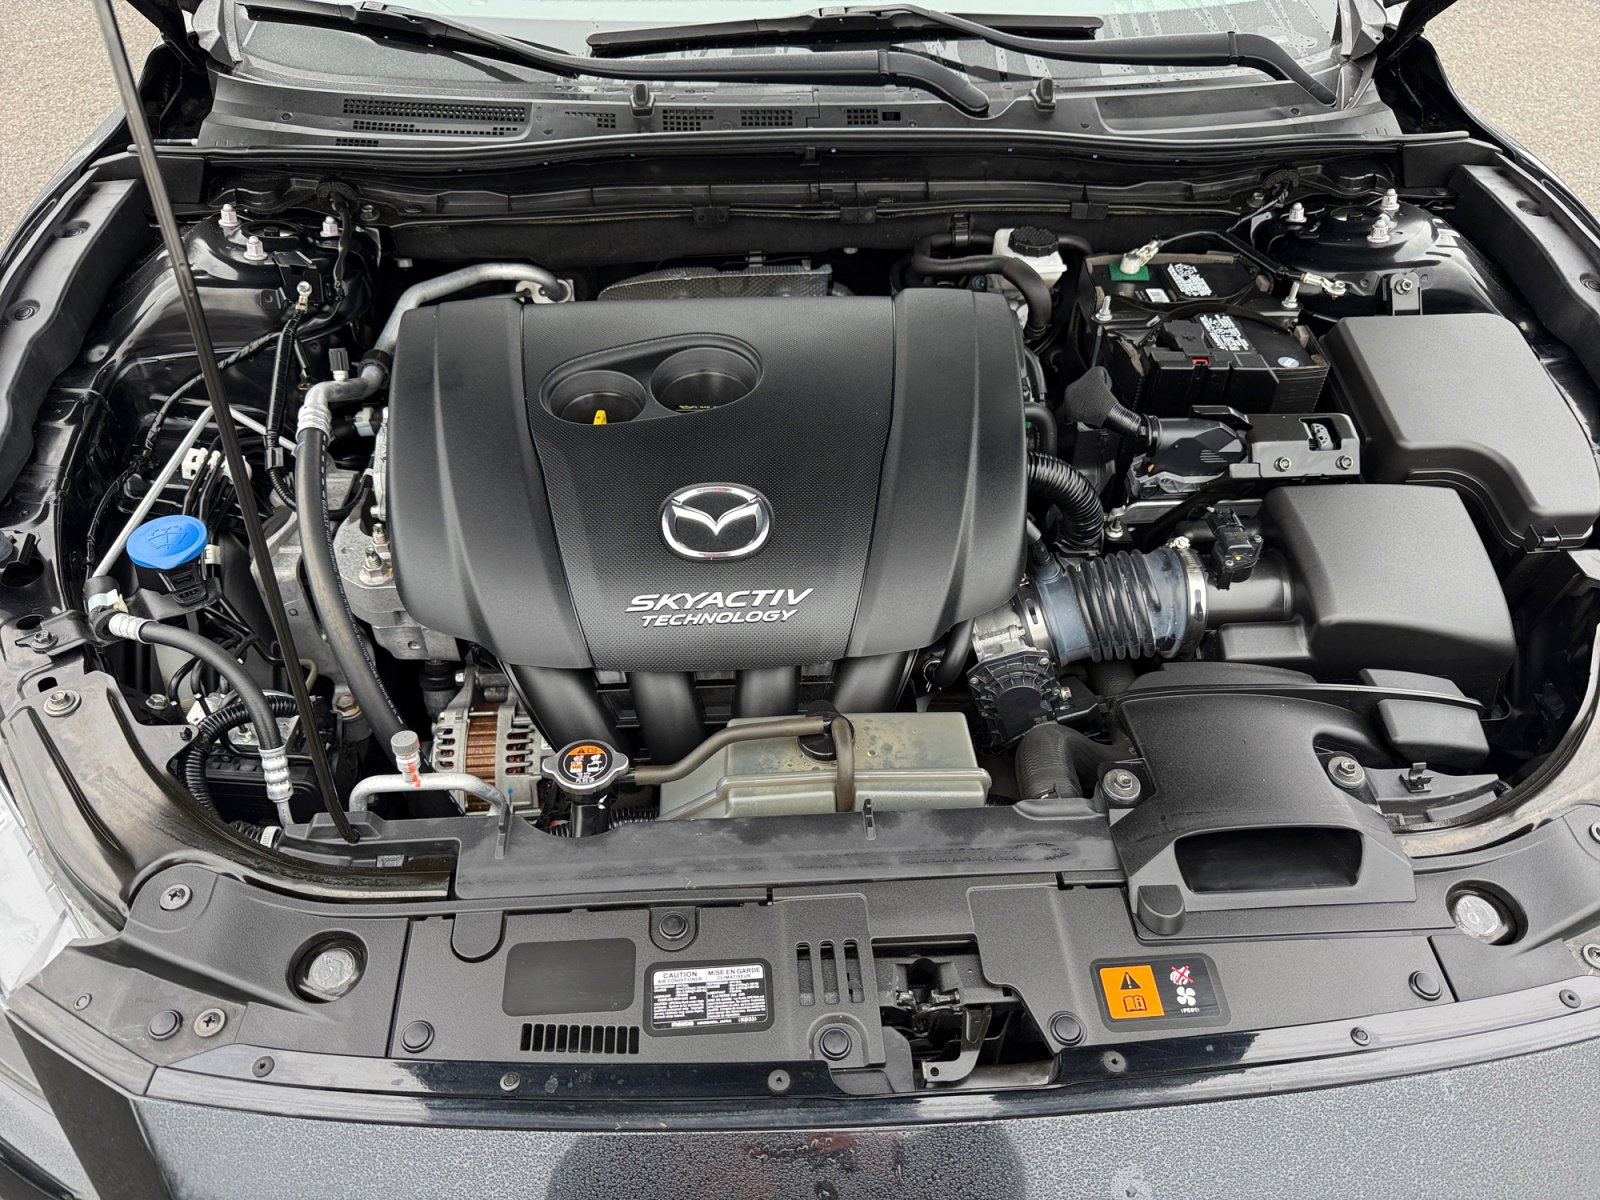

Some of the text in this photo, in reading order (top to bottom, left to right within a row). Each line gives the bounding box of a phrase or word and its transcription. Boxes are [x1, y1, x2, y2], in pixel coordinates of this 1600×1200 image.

[625, 588, 814, 612] SKYACTIV
[641, 610, 798, 627] TECHNOLOGY
[663, 971, 697, 979] CAUTION
